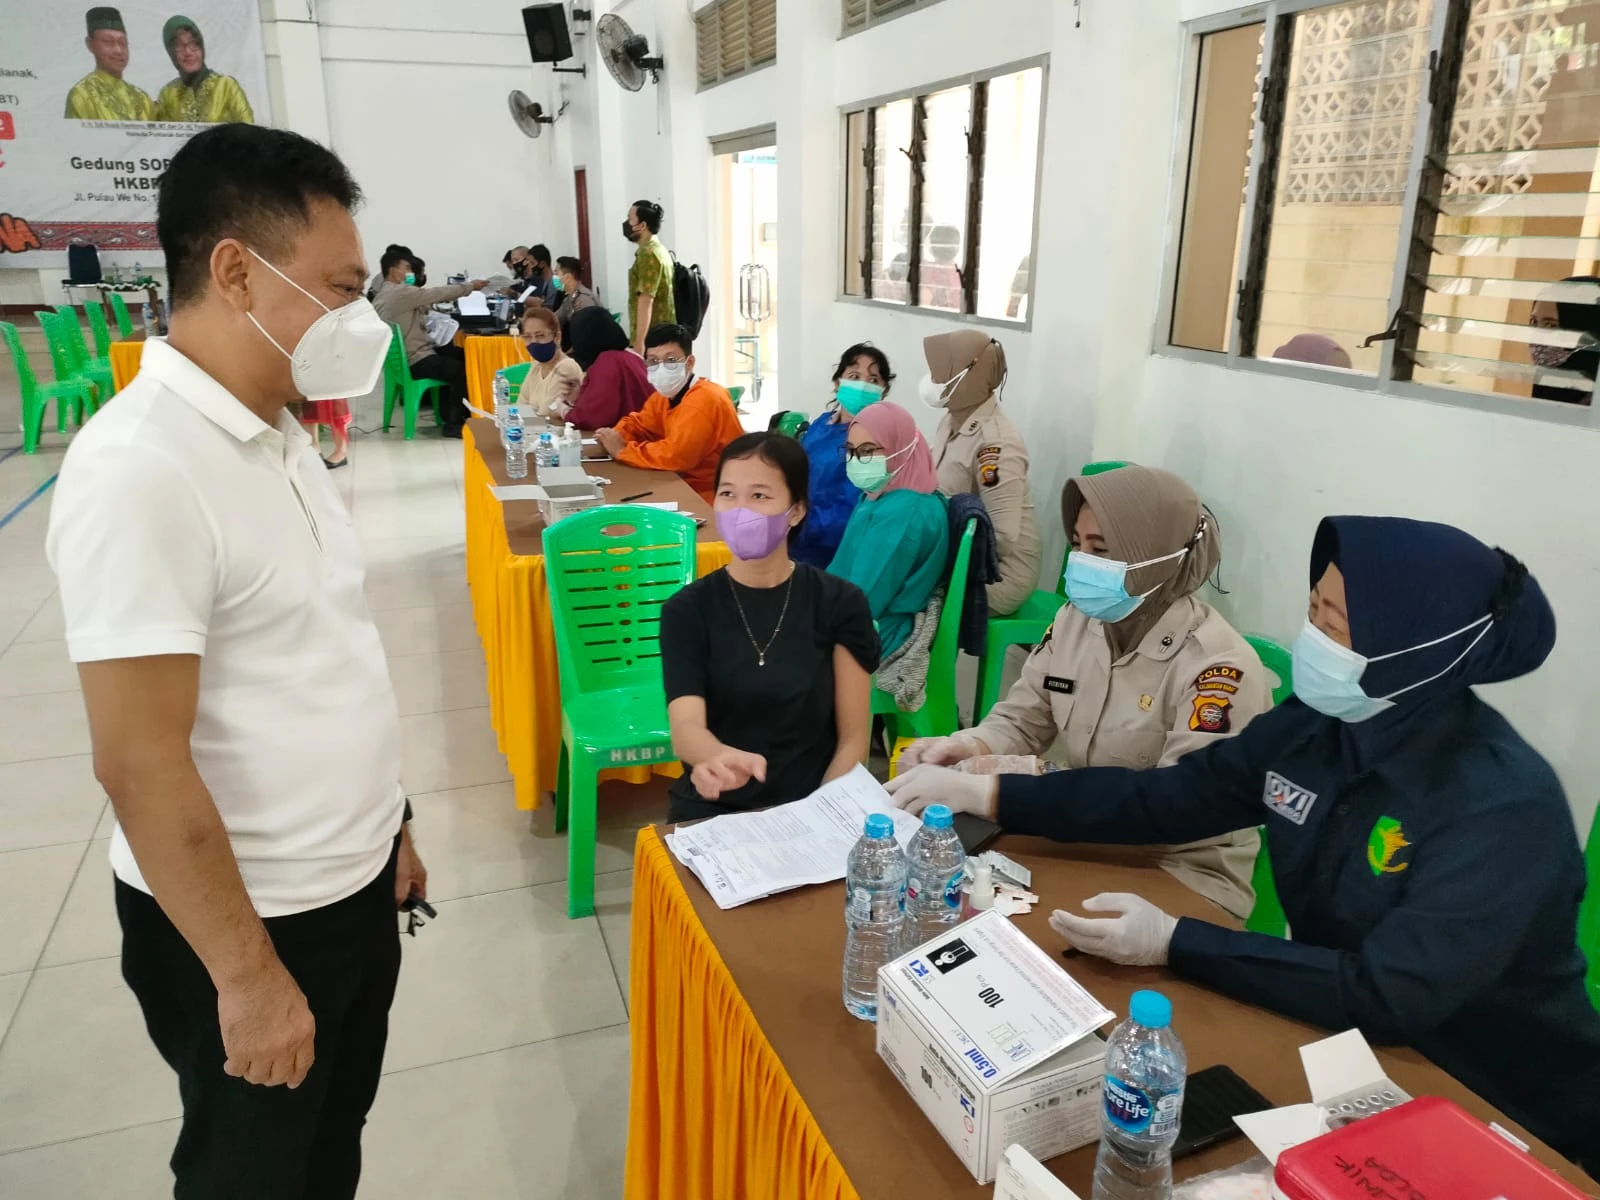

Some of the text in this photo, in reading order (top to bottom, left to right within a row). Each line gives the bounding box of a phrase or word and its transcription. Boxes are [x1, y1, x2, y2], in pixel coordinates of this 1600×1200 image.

[70, 156, 135, 173] Gedung
[1198, 668, 1237, 683] POLDA
[611, 746, 665, 762] HKBP
[976, 986, 1005, 1009] 100
[963, 1047, 998, 1079] 0.5ml
[1125, 1101, 1151, 1118] Life
